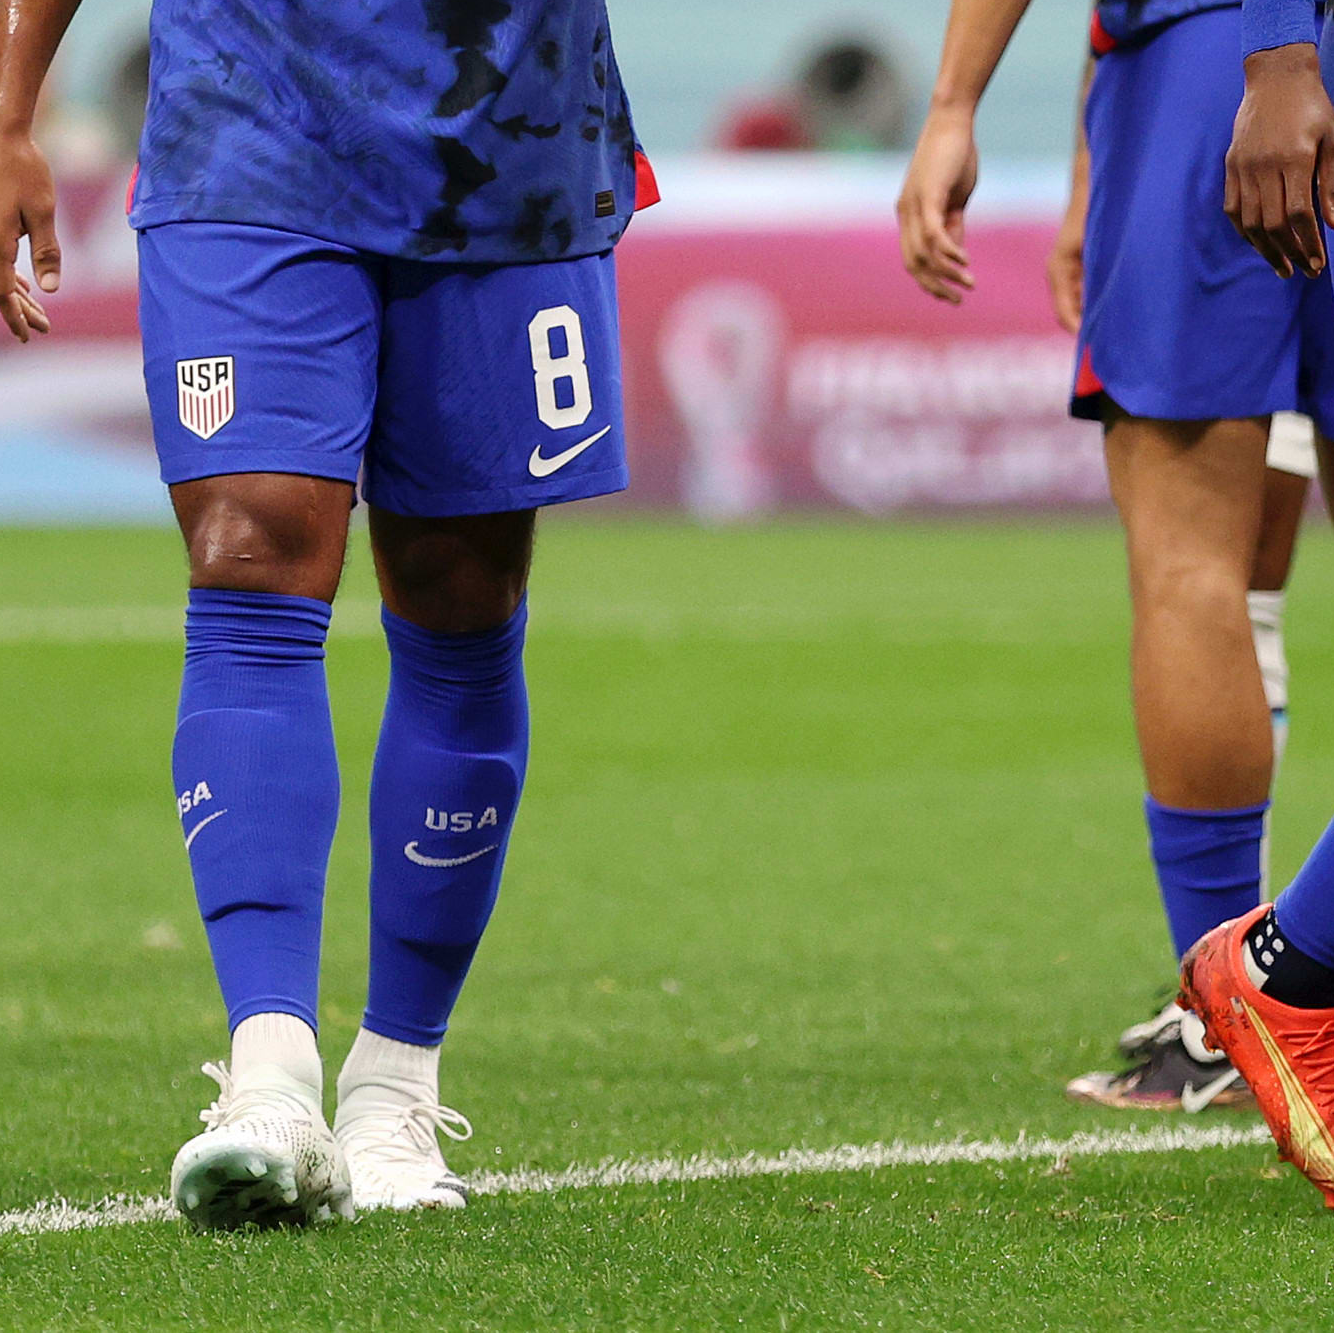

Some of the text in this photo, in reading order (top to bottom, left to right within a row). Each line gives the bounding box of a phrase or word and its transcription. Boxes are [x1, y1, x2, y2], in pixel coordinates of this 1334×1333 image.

[182, 362, 228, 392] USA
[527, 305, 593, 431] 8
[425, 807, 497, 832] USA
